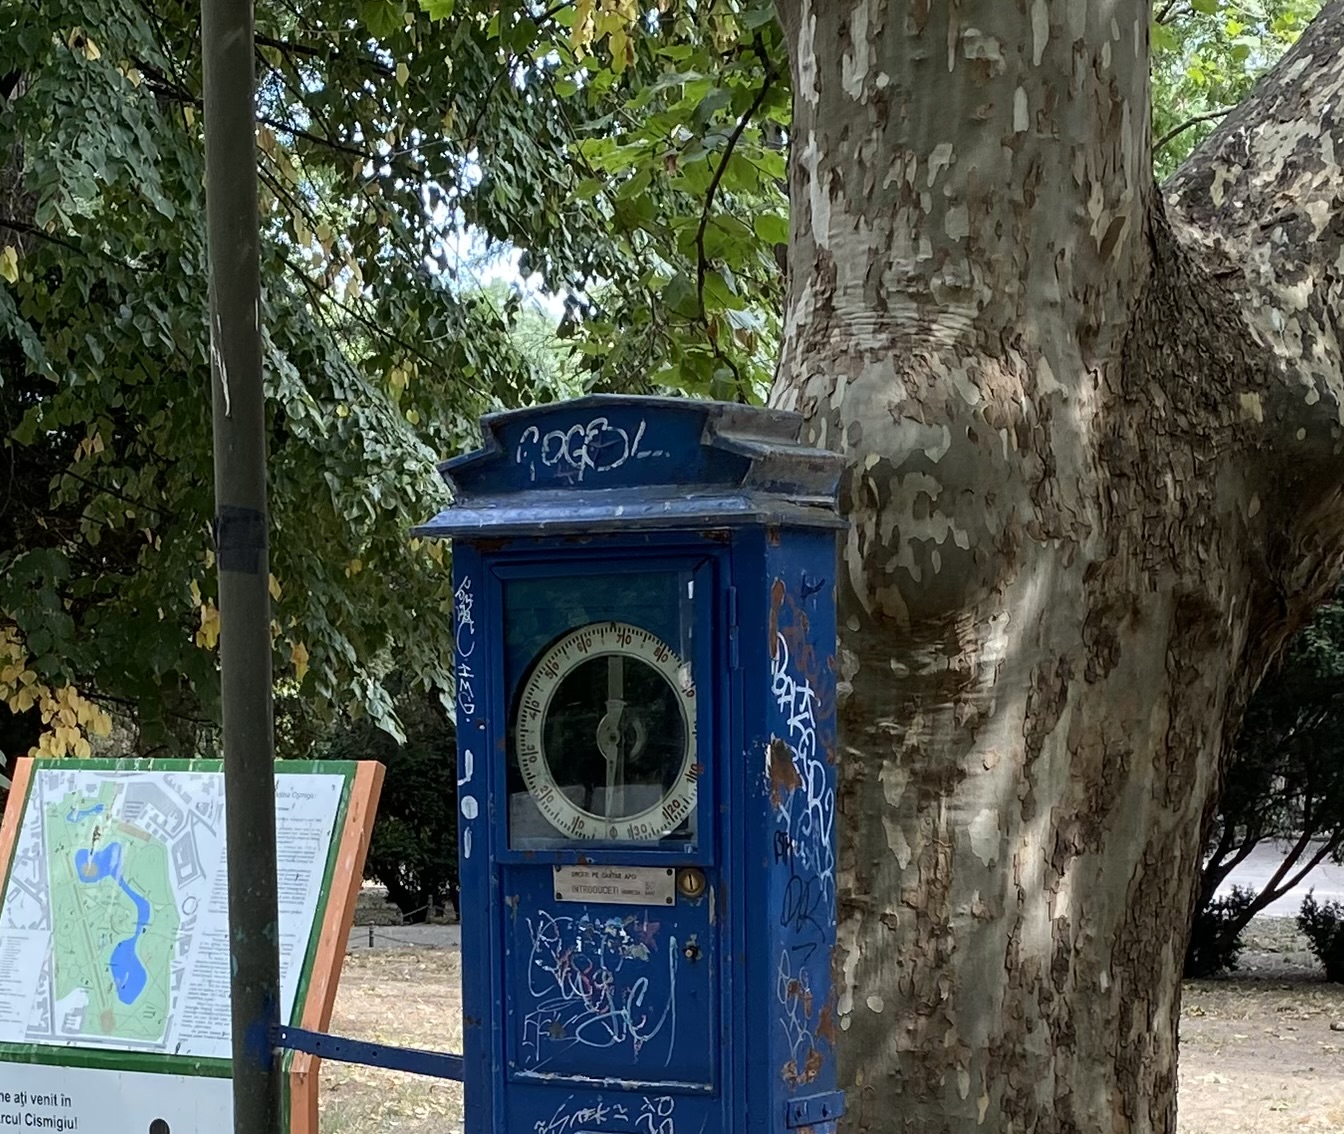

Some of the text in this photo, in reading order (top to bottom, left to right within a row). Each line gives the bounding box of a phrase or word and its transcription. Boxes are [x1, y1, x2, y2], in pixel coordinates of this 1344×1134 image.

[546, 662, 559, 679] 50
[530, 700, 540, 721] 40
[31, 1093, 58, 1106] venit
[61, 1093, 71, 1107] în
